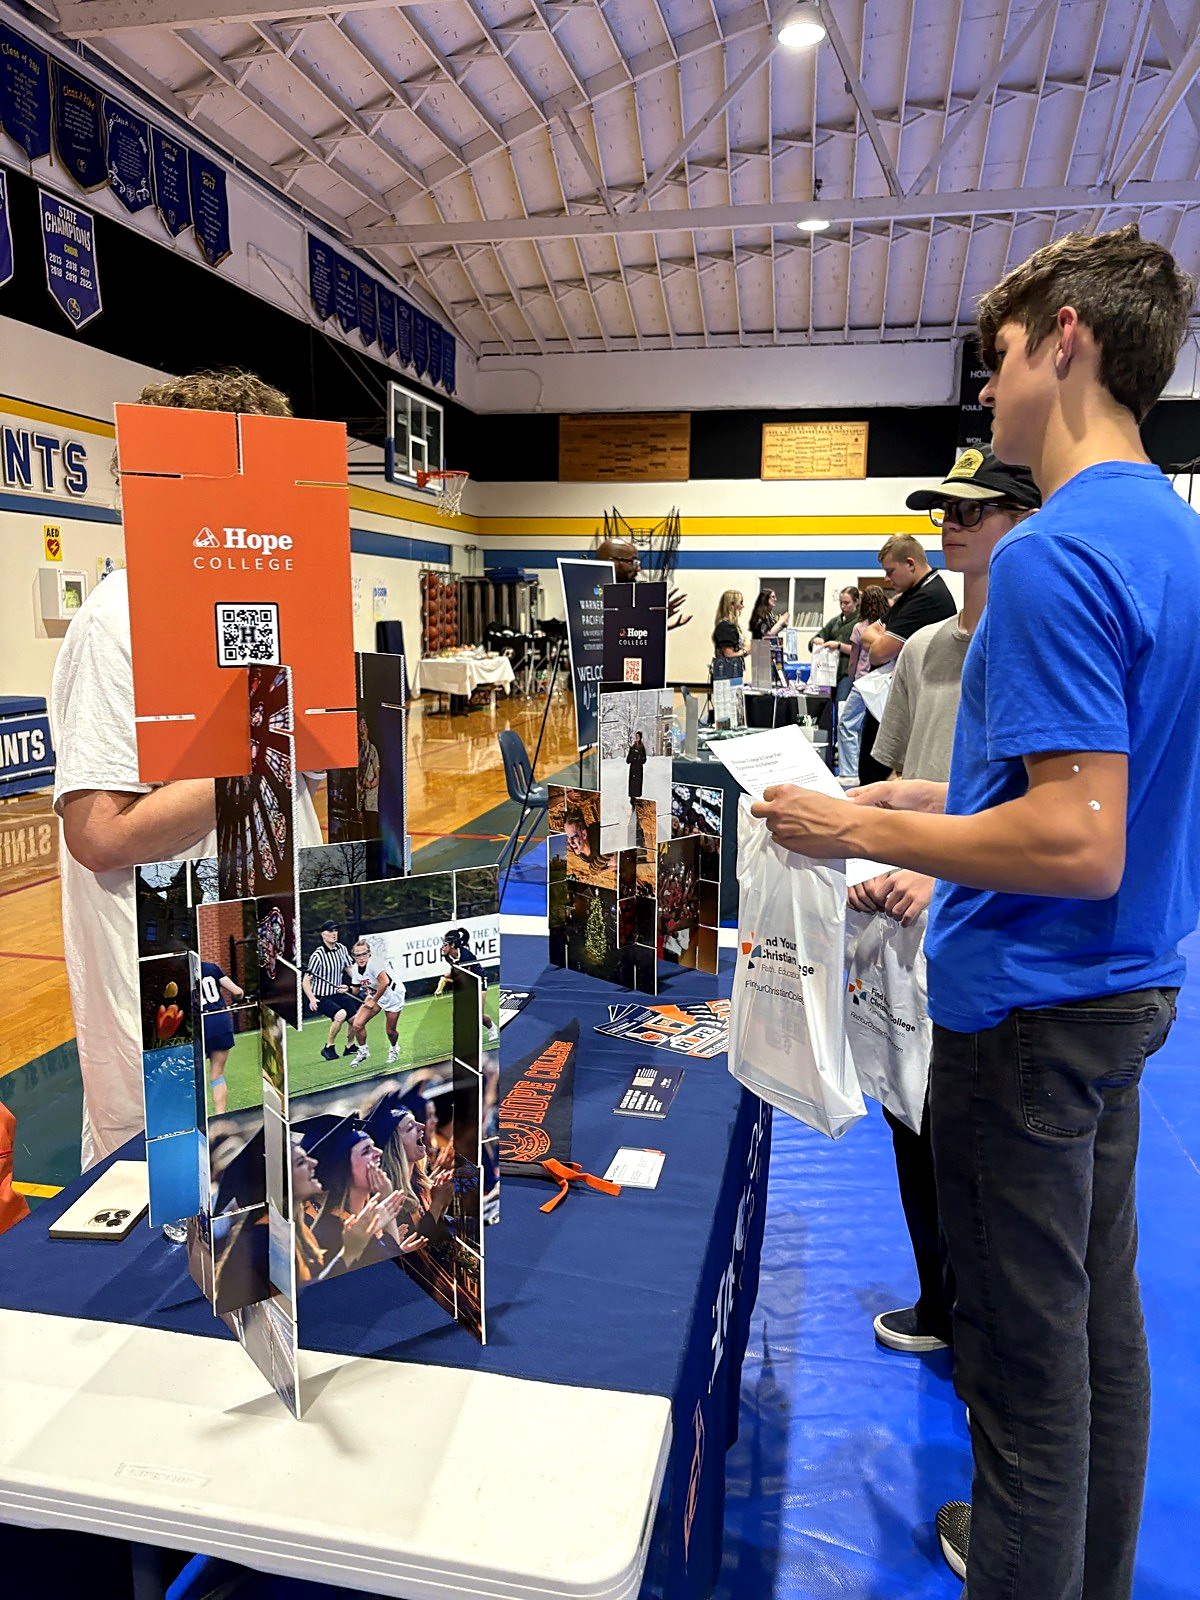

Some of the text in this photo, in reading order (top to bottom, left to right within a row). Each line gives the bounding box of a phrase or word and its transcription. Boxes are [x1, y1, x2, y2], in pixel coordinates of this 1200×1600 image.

[58, 205, 77, 225] STATE
[45, 211, 91, 252] CHAMPIONS
[970, 371, 992, 379] HOM
[46, 528, 60, 538] AED
[223, 527, 293, 555] Hope
[193, 557, 293, 571] COLLEGE
[579, 600, 604, 610] WARNER
[627, 628, 648, 642] Hope
[618, 639, 648, 647] COLLEGE
[577, 665, 604, 682] WELCO
[0, 728, 46, 768] NTS
[473, 930, 490, 940] THE
[765, 937, 778, 948] nd
[778, 966, 801, 980] Educatio
[201, 975, 220, 1005] 0
[871, 987, 883, 1000] Find
[889, 1013, 916, 1032] College
[524, 1040, 574, 1079] COLLEGE
[499, 1080, 557, 1124] HOPE
